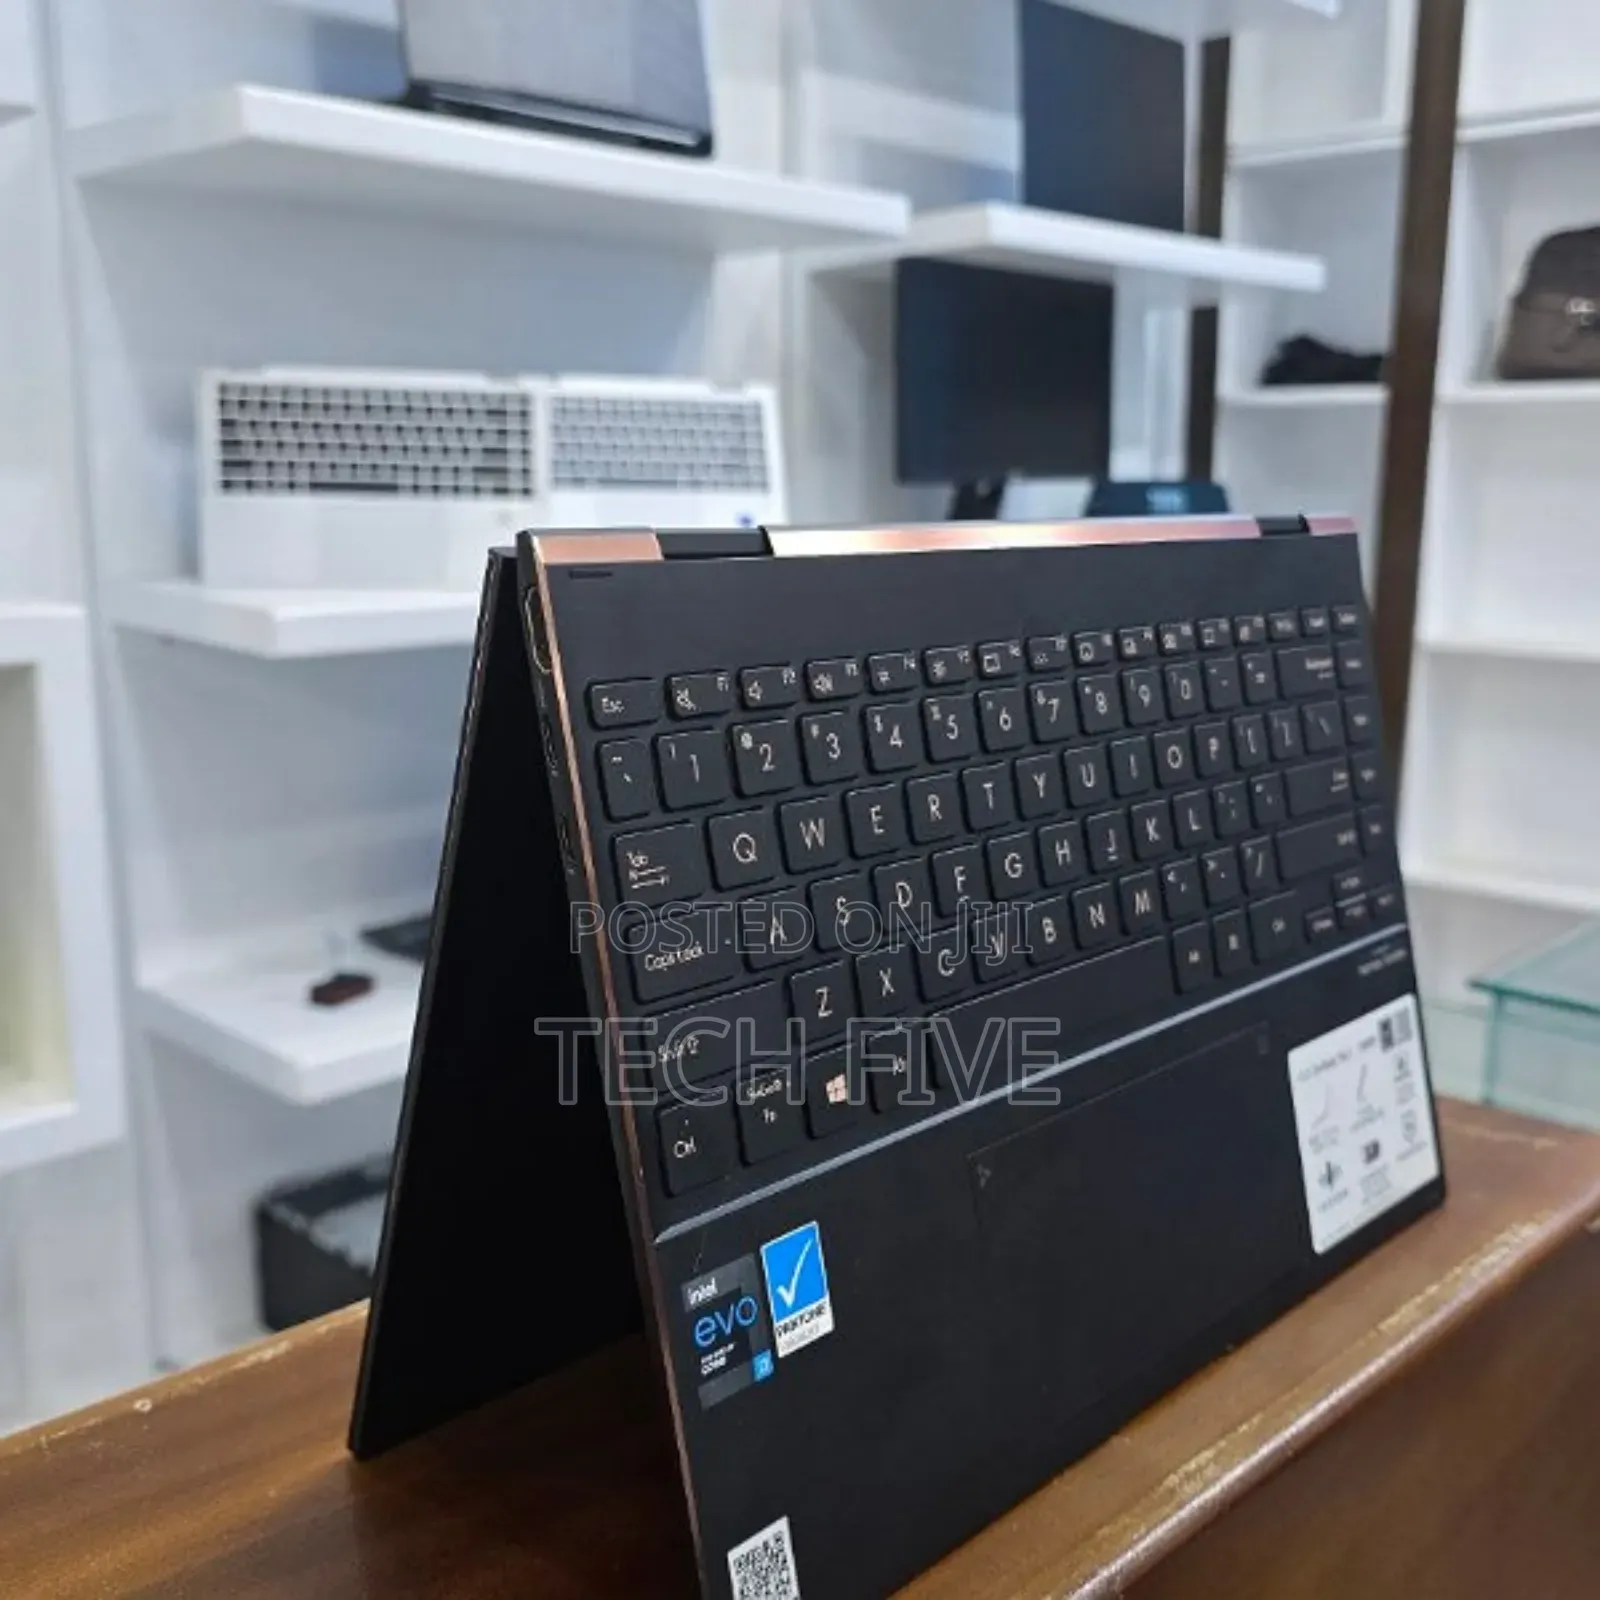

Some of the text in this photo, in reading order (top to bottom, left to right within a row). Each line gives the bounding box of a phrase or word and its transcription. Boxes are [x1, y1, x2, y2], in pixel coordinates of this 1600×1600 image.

[759, 743, 776, 772] 2
[826, 732, 841, 760] 3
[889, 724, 903, 748] 4
[946, 714, 959, 740] 5
[999, 707, 1012, 731] 6
[1047, 698, 1060, 723] 7
[1095, 691, 1108, 715] 8
[1138, 684, 1150, 707] 9
[732, 833, 758, 863] Q
[799, 817, 826, 850] W
[871, 804, 884, 835] E
[927, 793, 943, 822] R
[983, 782, 994, 809] T
[1033, 772, 1047, 798] Y
[1080, 762, 1095, 788] U
[1166, 745, 1183, 769] O
[1208, 736, 1219, 760] P
[769, 916, 787, 945] A
[836, 896, 850, 927] S
[895, 882, 913, 908] D
[953, 866, 966, 893] F
[1004, 852, 1023, 878] G
[1055, 839, 1071, 866] H
[1145, 817, 1160, 842] K
[1188, 808, 1202, 831] L
[815, 987, 833, 1018] Z
[879, 968, 895, 996] X
[938, 949, 956, 976] C
[1042, 917, 1057, 943] B
[1089, 903, 1106, 929] N
[1134, 889, 1151, 916] M
[694, 1295, 758, 1347] evo
